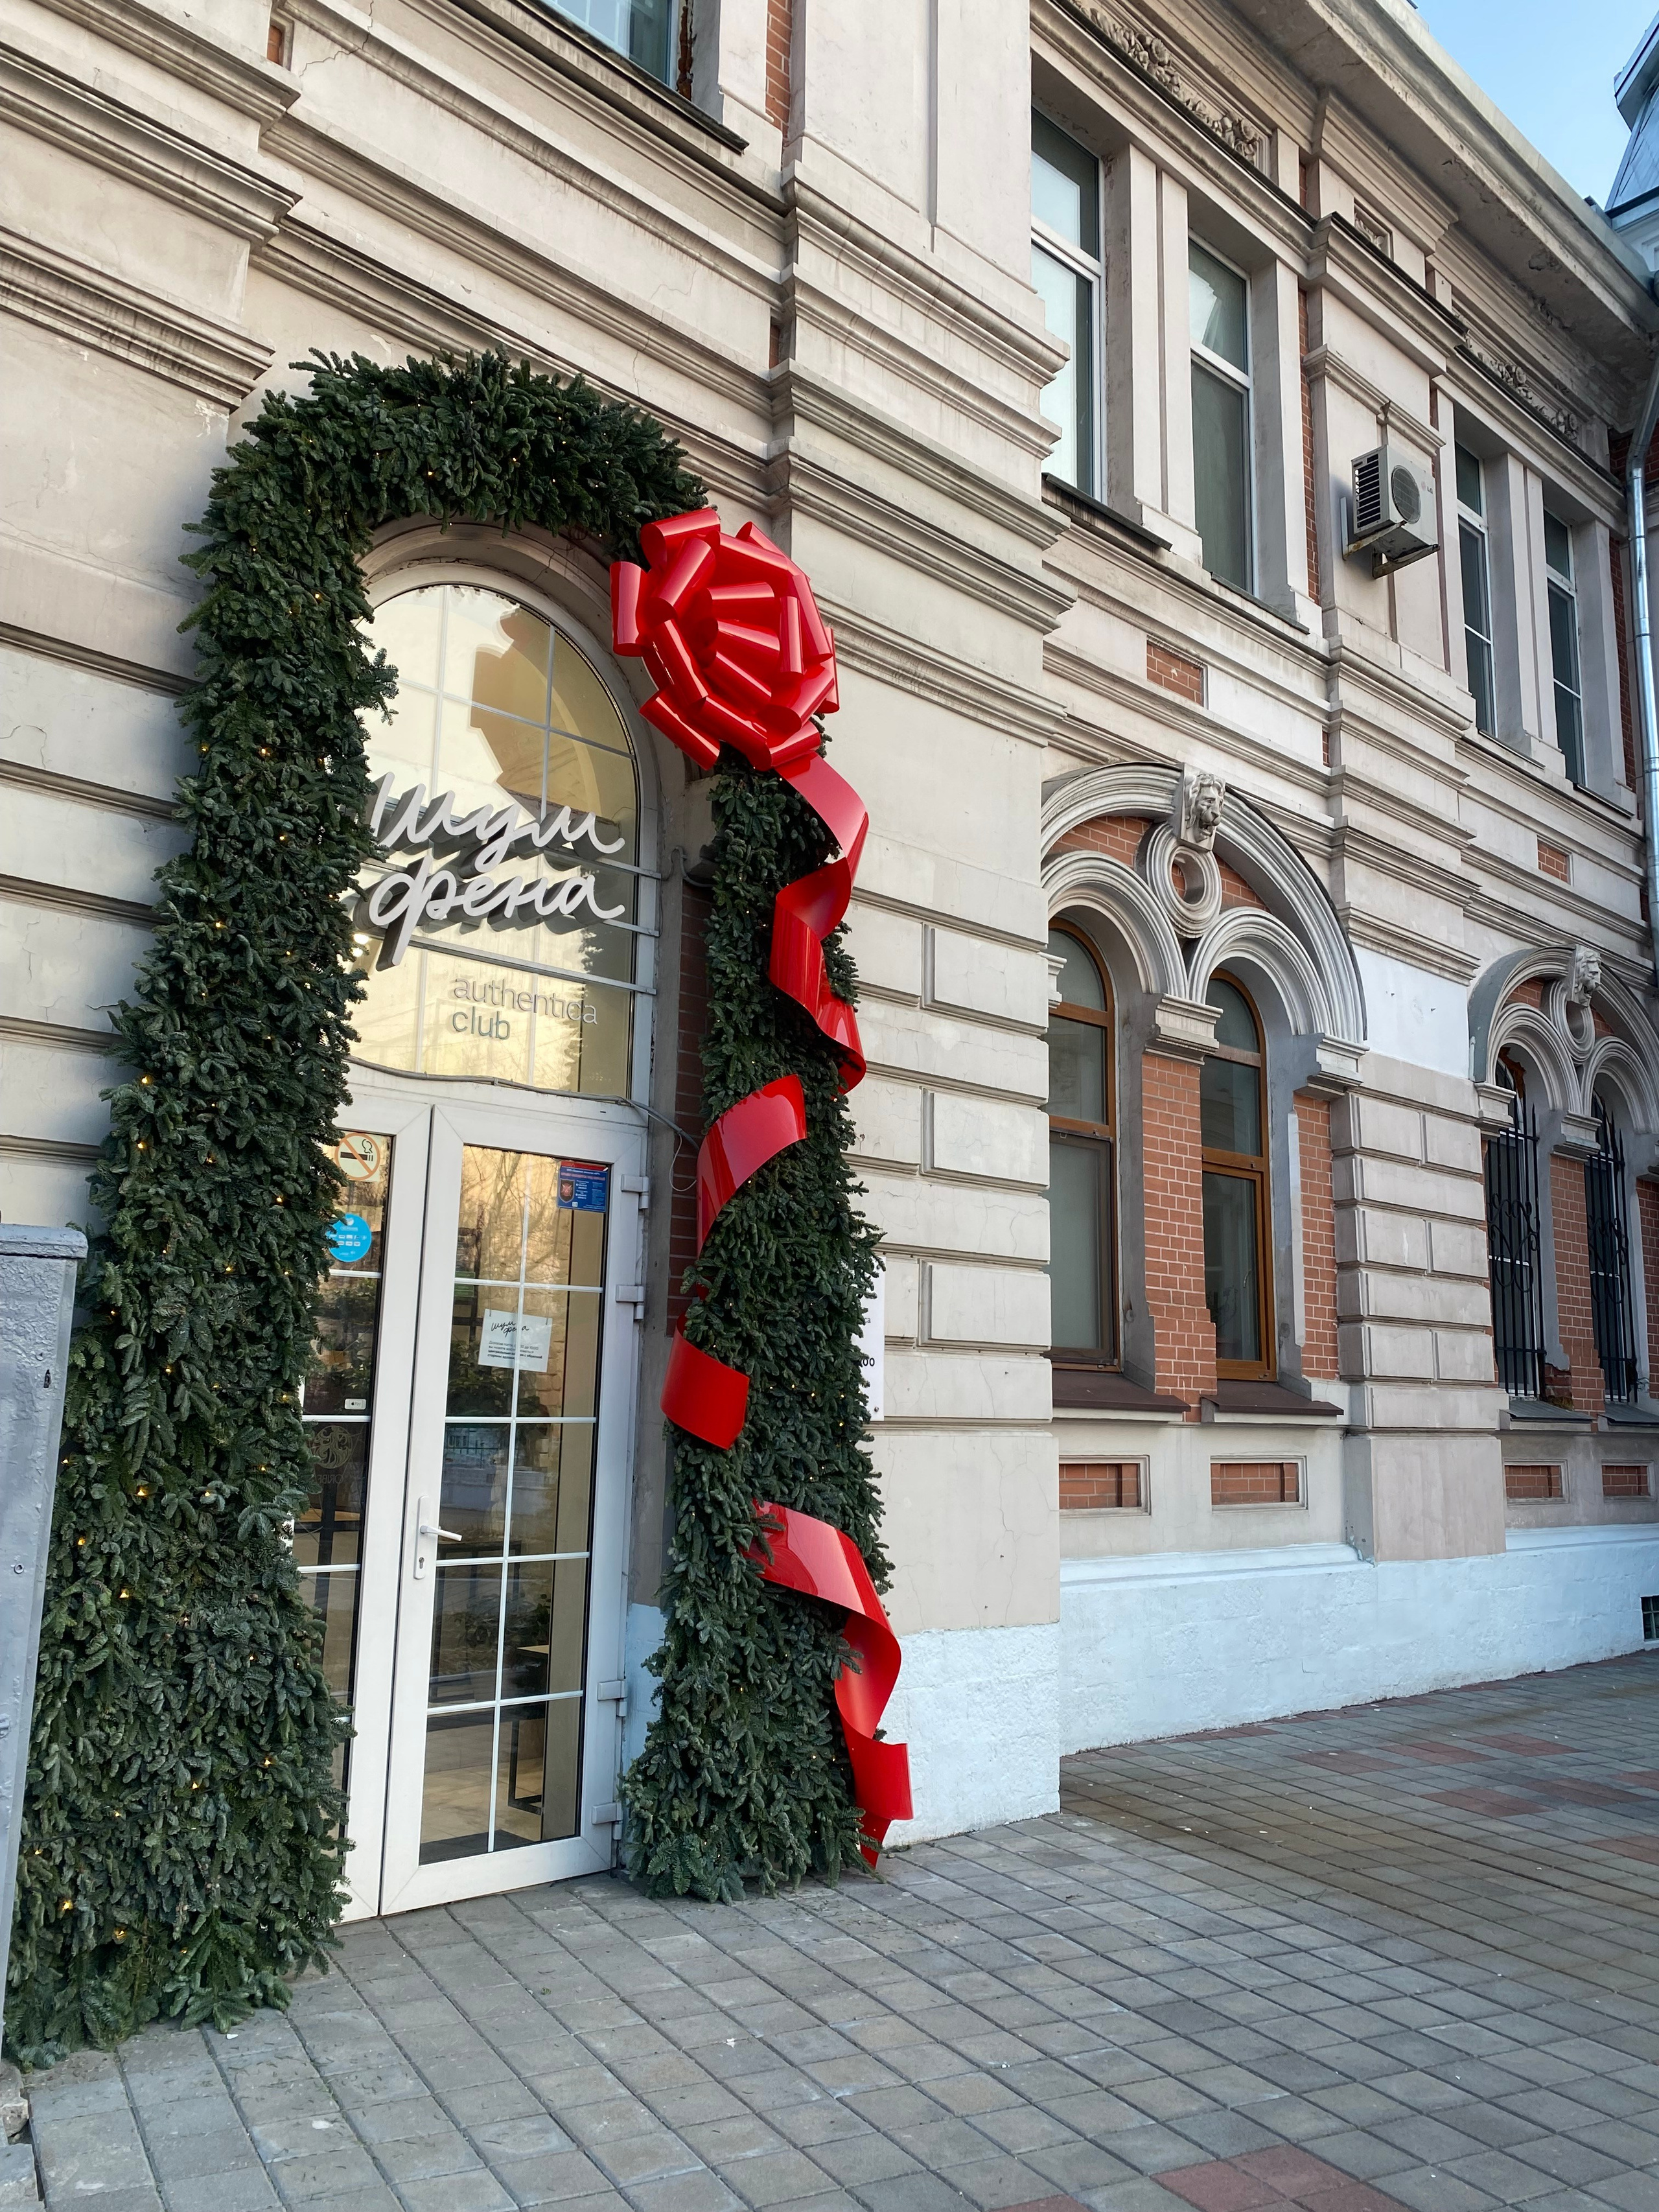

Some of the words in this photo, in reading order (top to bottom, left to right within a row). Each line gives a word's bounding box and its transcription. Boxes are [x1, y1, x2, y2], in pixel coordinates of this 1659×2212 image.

[1427, 486, 1433, 495] LG
[364, 856, 626, 968] фена
[454, 977, 598, 1025] authentica
[452, 1006, 511, 1040] club
[503, 1325, 529, 1338] феа
